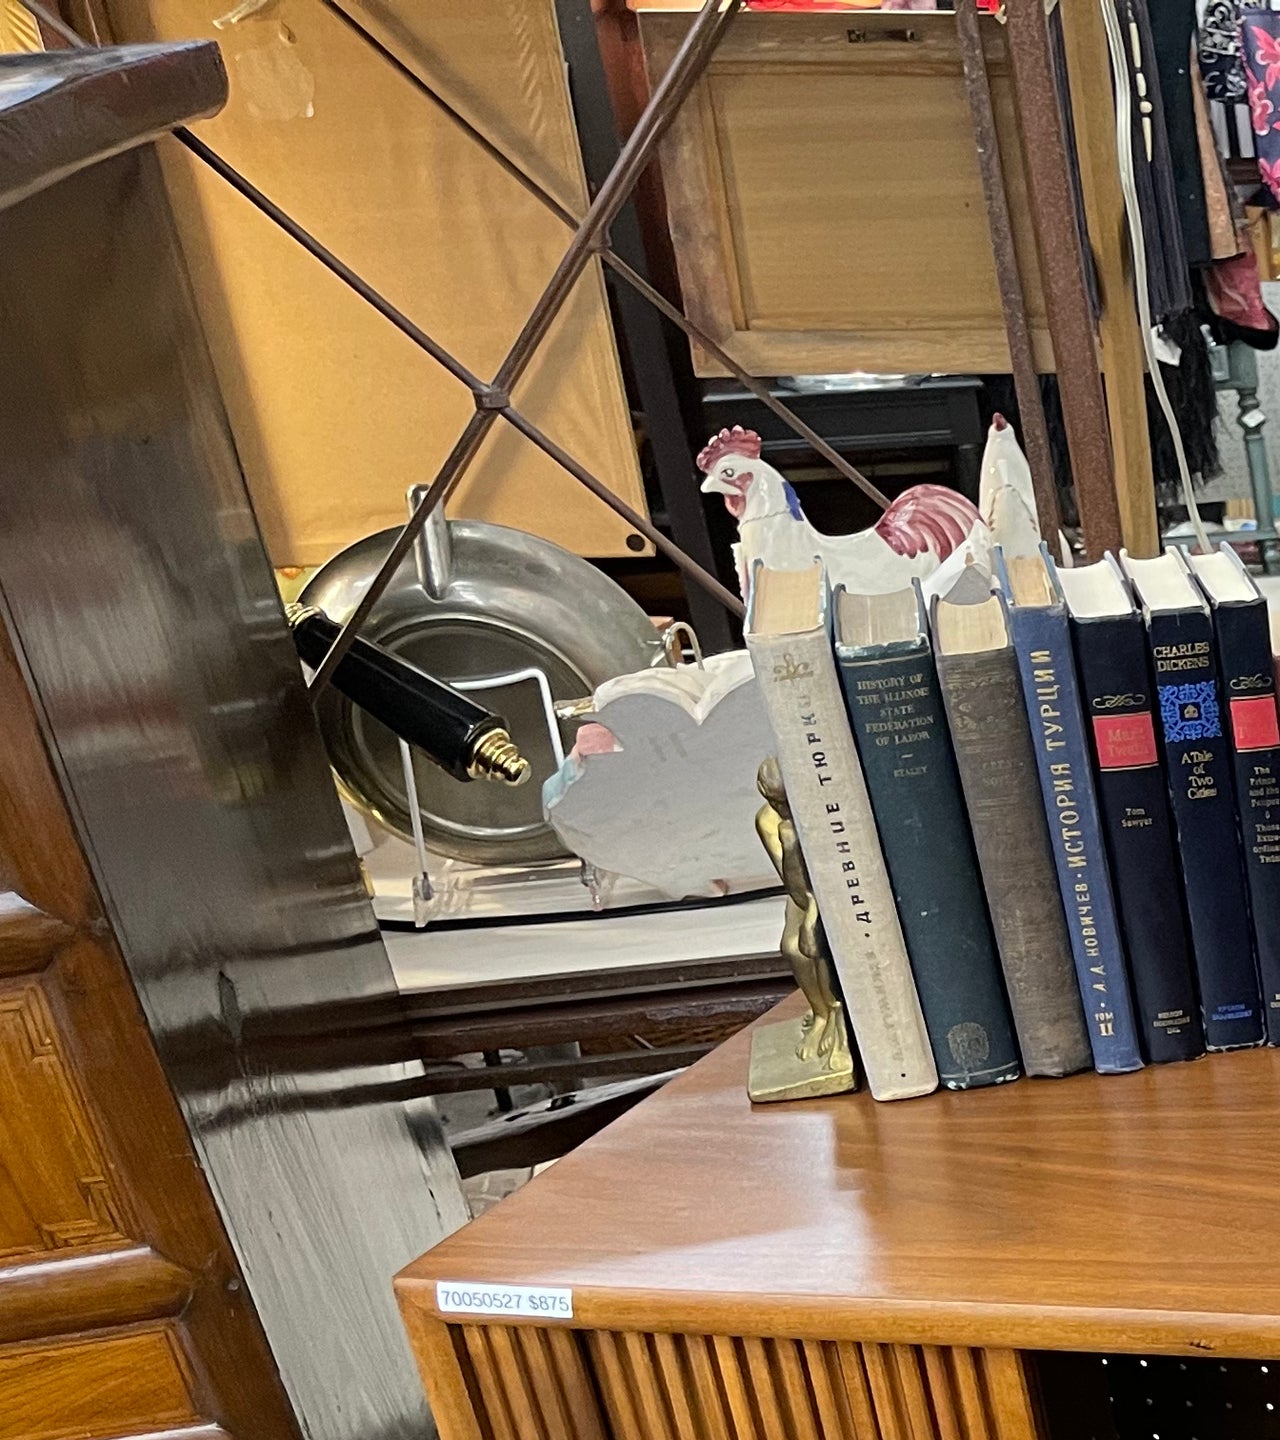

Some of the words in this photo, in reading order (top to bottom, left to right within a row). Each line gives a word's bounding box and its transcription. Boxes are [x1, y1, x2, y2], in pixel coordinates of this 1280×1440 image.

[1153, 641, 1210, 659] CHARLES
[1156, 656, 1210, 673] DICKENS
[856, 676, 906, 691] HISTORY
[909, 673, 924, 685] OF
[855, 694, 881, 706] THE
[1029, 650, 1067, 752] ТУРЦИИ
[879, 704, 916, 718] STATE
[864, 714, 935, 734] FEDERATION
[875, 736, 890, 747] OF
[894, 730, 930, 746] LABOR
[1181, 753, 1191, 764] A
[1190, 750, 1214, 763] Tale
[1193, 763, 1206, 775] of
[1188, 775, 1214, 788] Two
[1050, 763, 1088, 869] ИСТОРИЯ
[1125, 808, 1146, 816] Tom
[825, 801, 873, 925] ДРЕВНИЕ
[1074, 883, 1100, 957] НОВИЧЕВ
[440, 1290, 522, 1310] 70050527
[527, 1294, 570, 1312] $875
